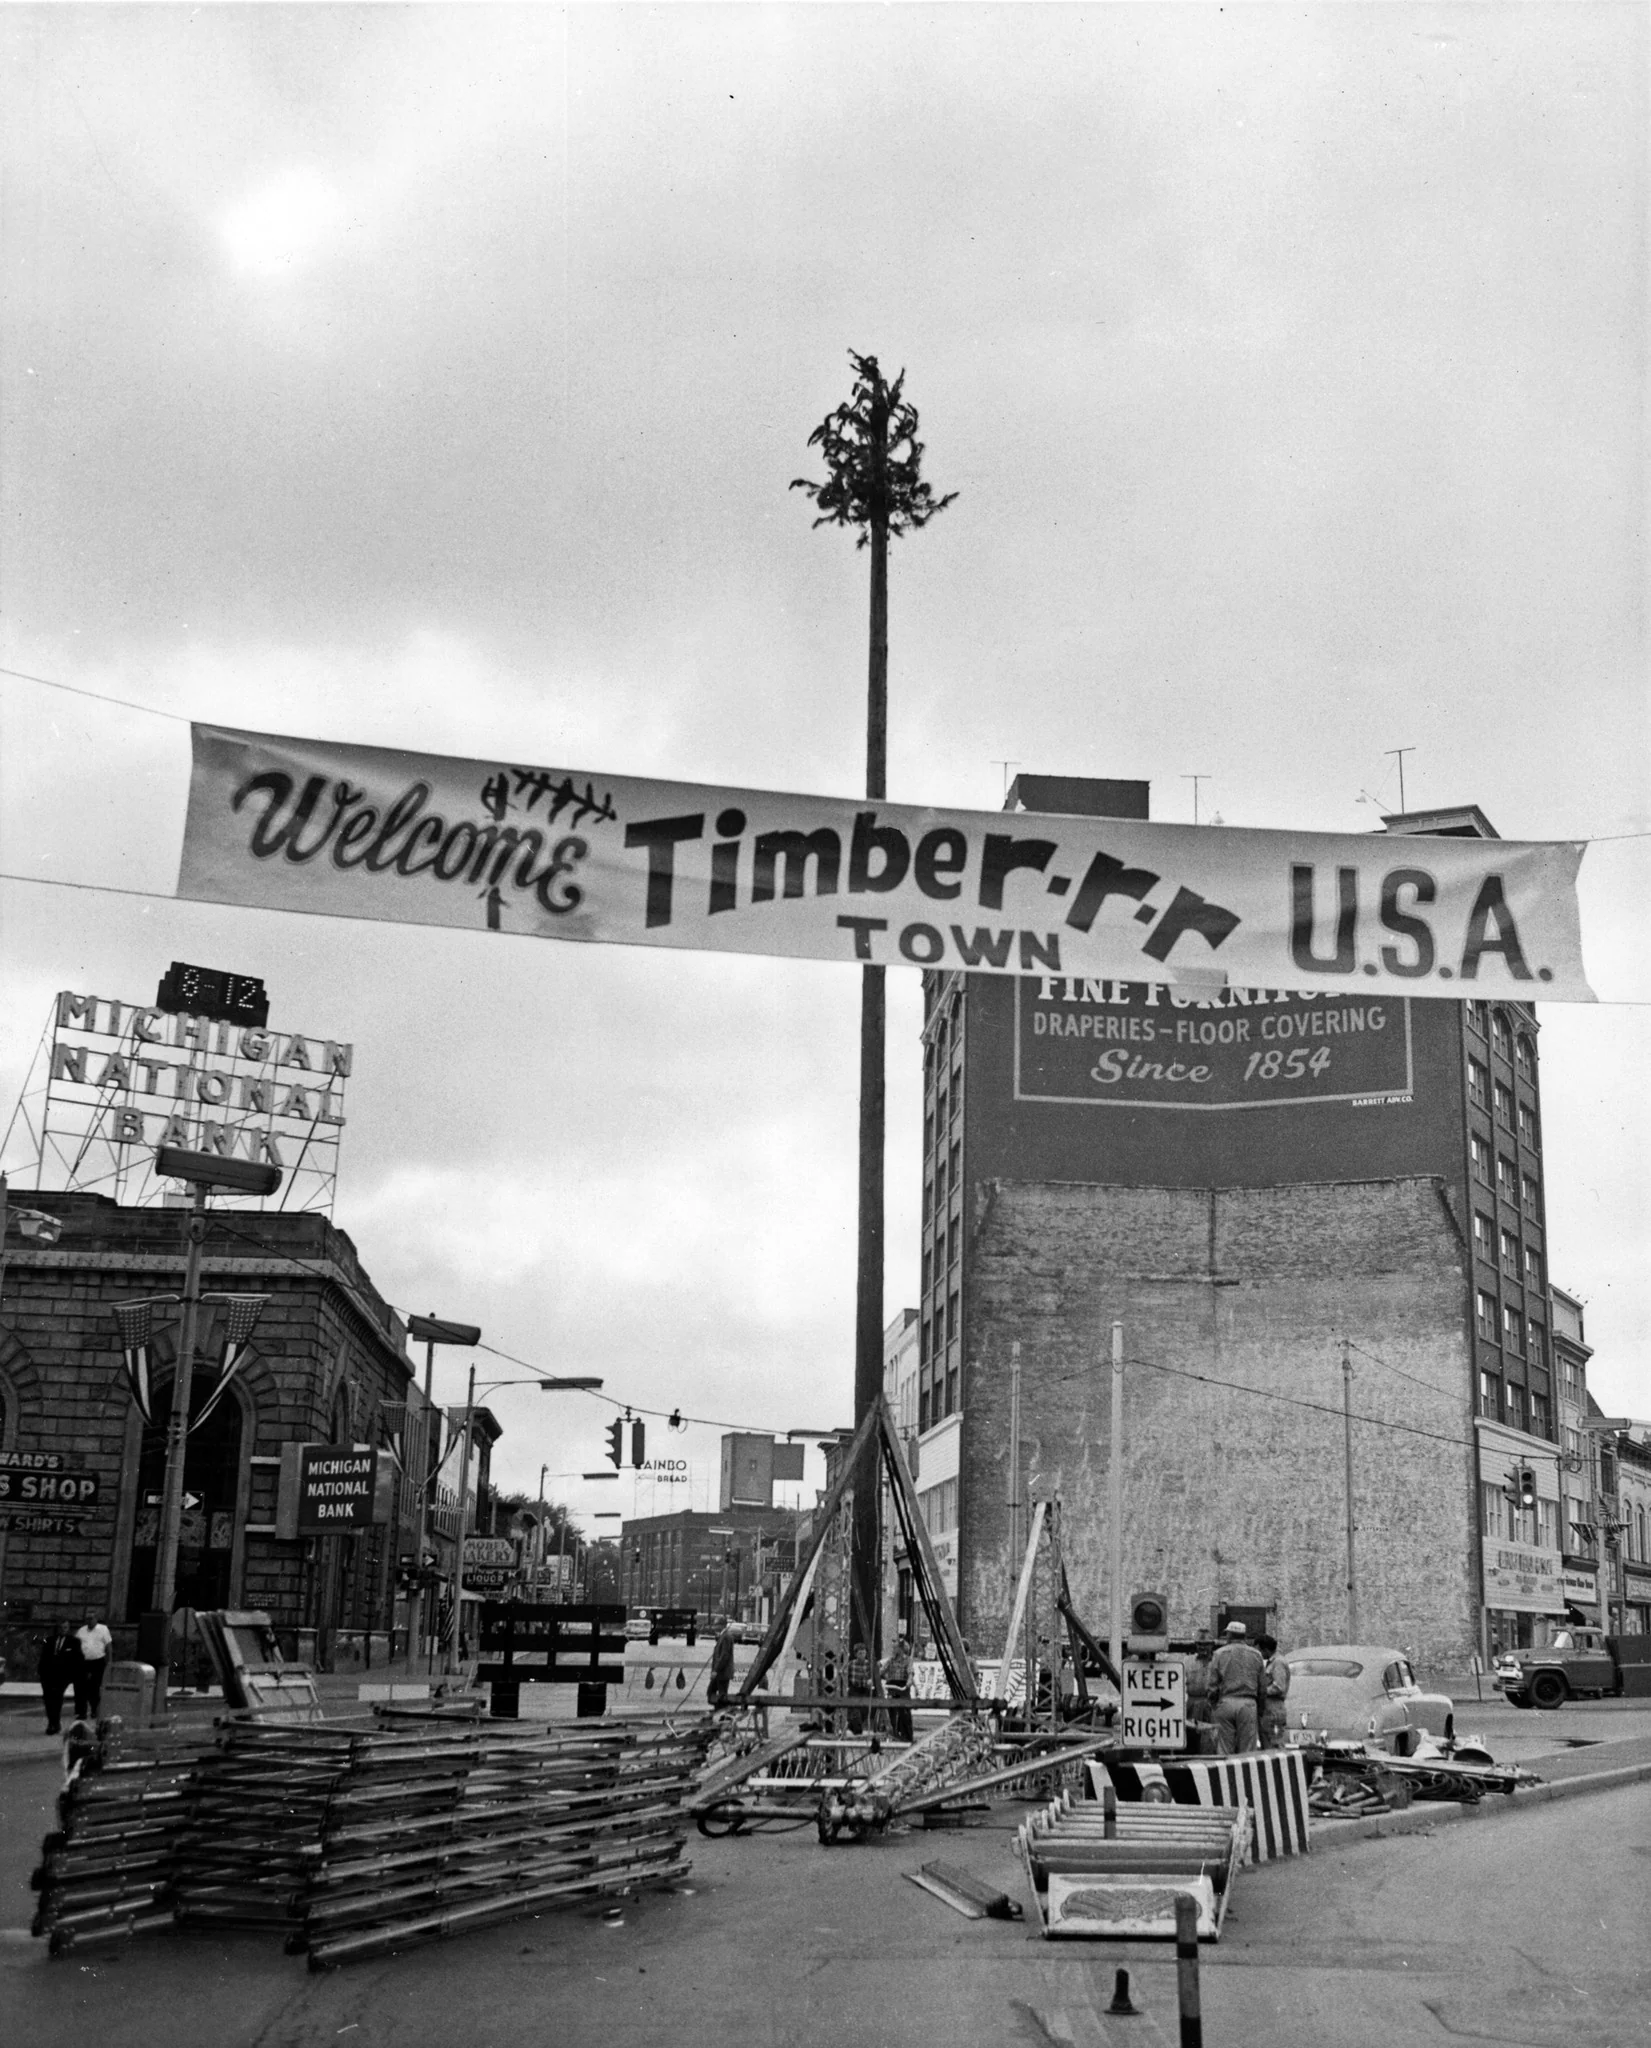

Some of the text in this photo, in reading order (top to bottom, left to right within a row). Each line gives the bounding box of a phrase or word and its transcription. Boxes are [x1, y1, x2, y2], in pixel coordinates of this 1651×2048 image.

[1290, 861, 1556, 983] U.S.A.
[836, 914, 1062, 972] TOWN
[1038, 976, 1130, 1004] FINE
[58, 991, 353, 1077] MICHIGAN
[1261, 1006, 1386, 1039] COVERING
[1090, 1046, 1331, 1083] Since 1854
[52, 1043, 346, 1126] NATIONAL
[112, 1106, 286, 1167] BANK
[308, 1459, 371, 1475] MICHIGAN
[643, 1459, 687, 1471] AINBO
[21, 1476, 96, 1501] SHOP
[308, 1481, 369, 1497] NATIONAL
[657, 1474, 688, 1483] BREAD
[318, 1503, 354, 1518] BANK
[15, 1516, 75, 1533] SHIRTS
[467, 1574, 504, 1583] LIQUOR
[1127, 1669, 1179, 1690] KEEP
[1124, 1717, 1182, 1738] RIGHT
